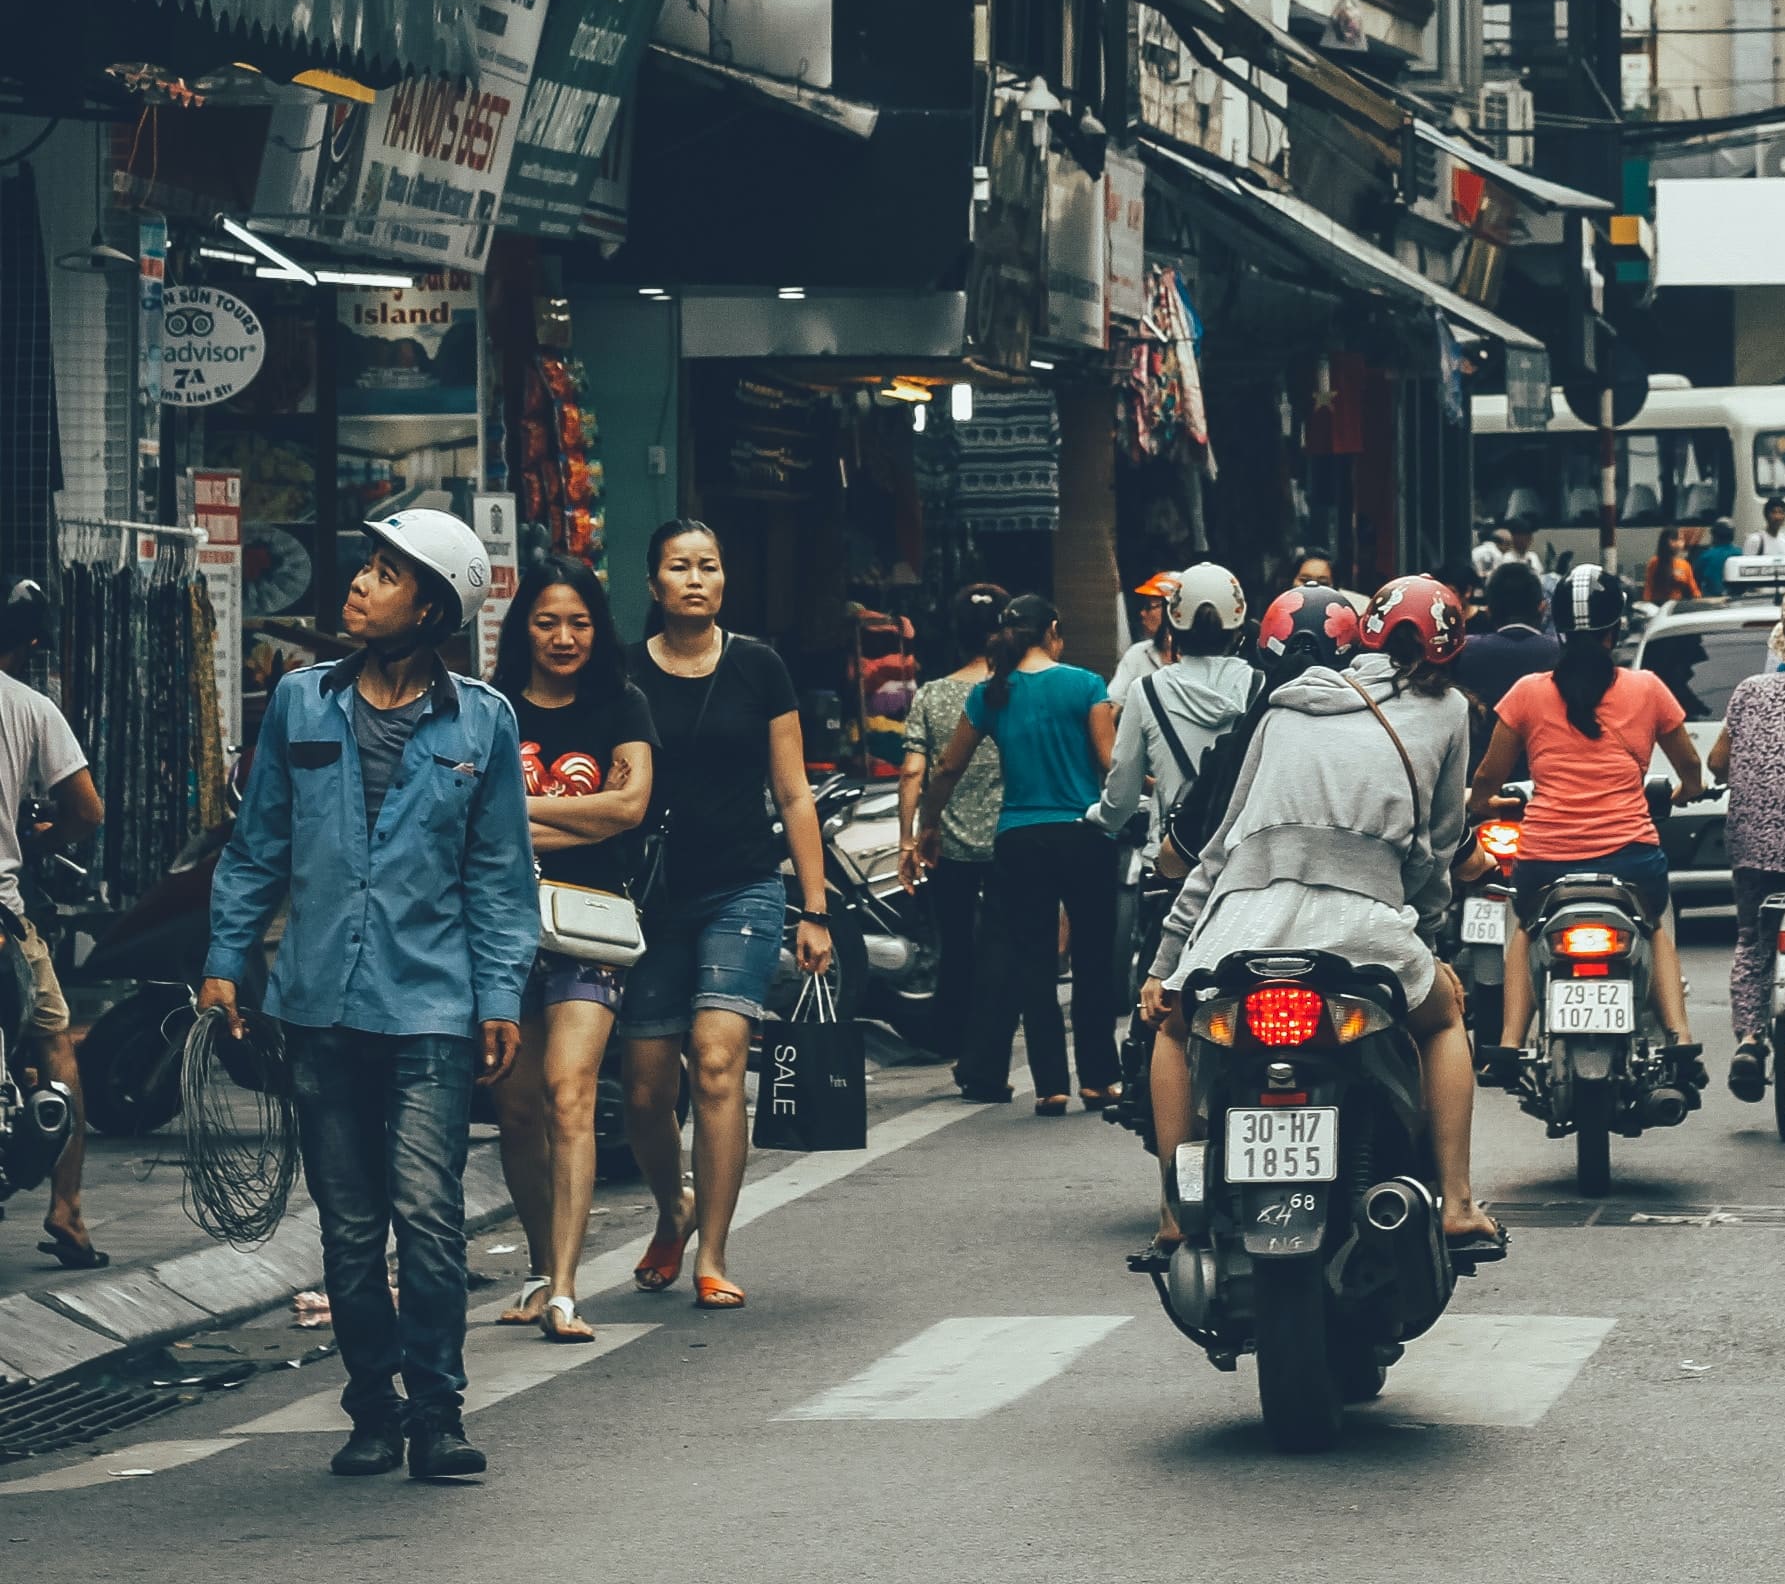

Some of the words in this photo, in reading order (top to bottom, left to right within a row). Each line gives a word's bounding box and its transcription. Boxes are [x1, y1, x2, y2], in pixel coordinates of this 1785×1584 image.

[454, 87, 512, 175] BEST
[216, 294, 259, 335] TOURS
[353, 301, 450, 324] Island
[1564, 985, 1620, 1006] 29-E2
[1558, 1007, 1626, 1028] 107.18
[772, 1044, 797, 1115] SALE
[1242, 1112, 1321, 1144] 30-H7
[1244, 1146, 1320, 1177] 1855
